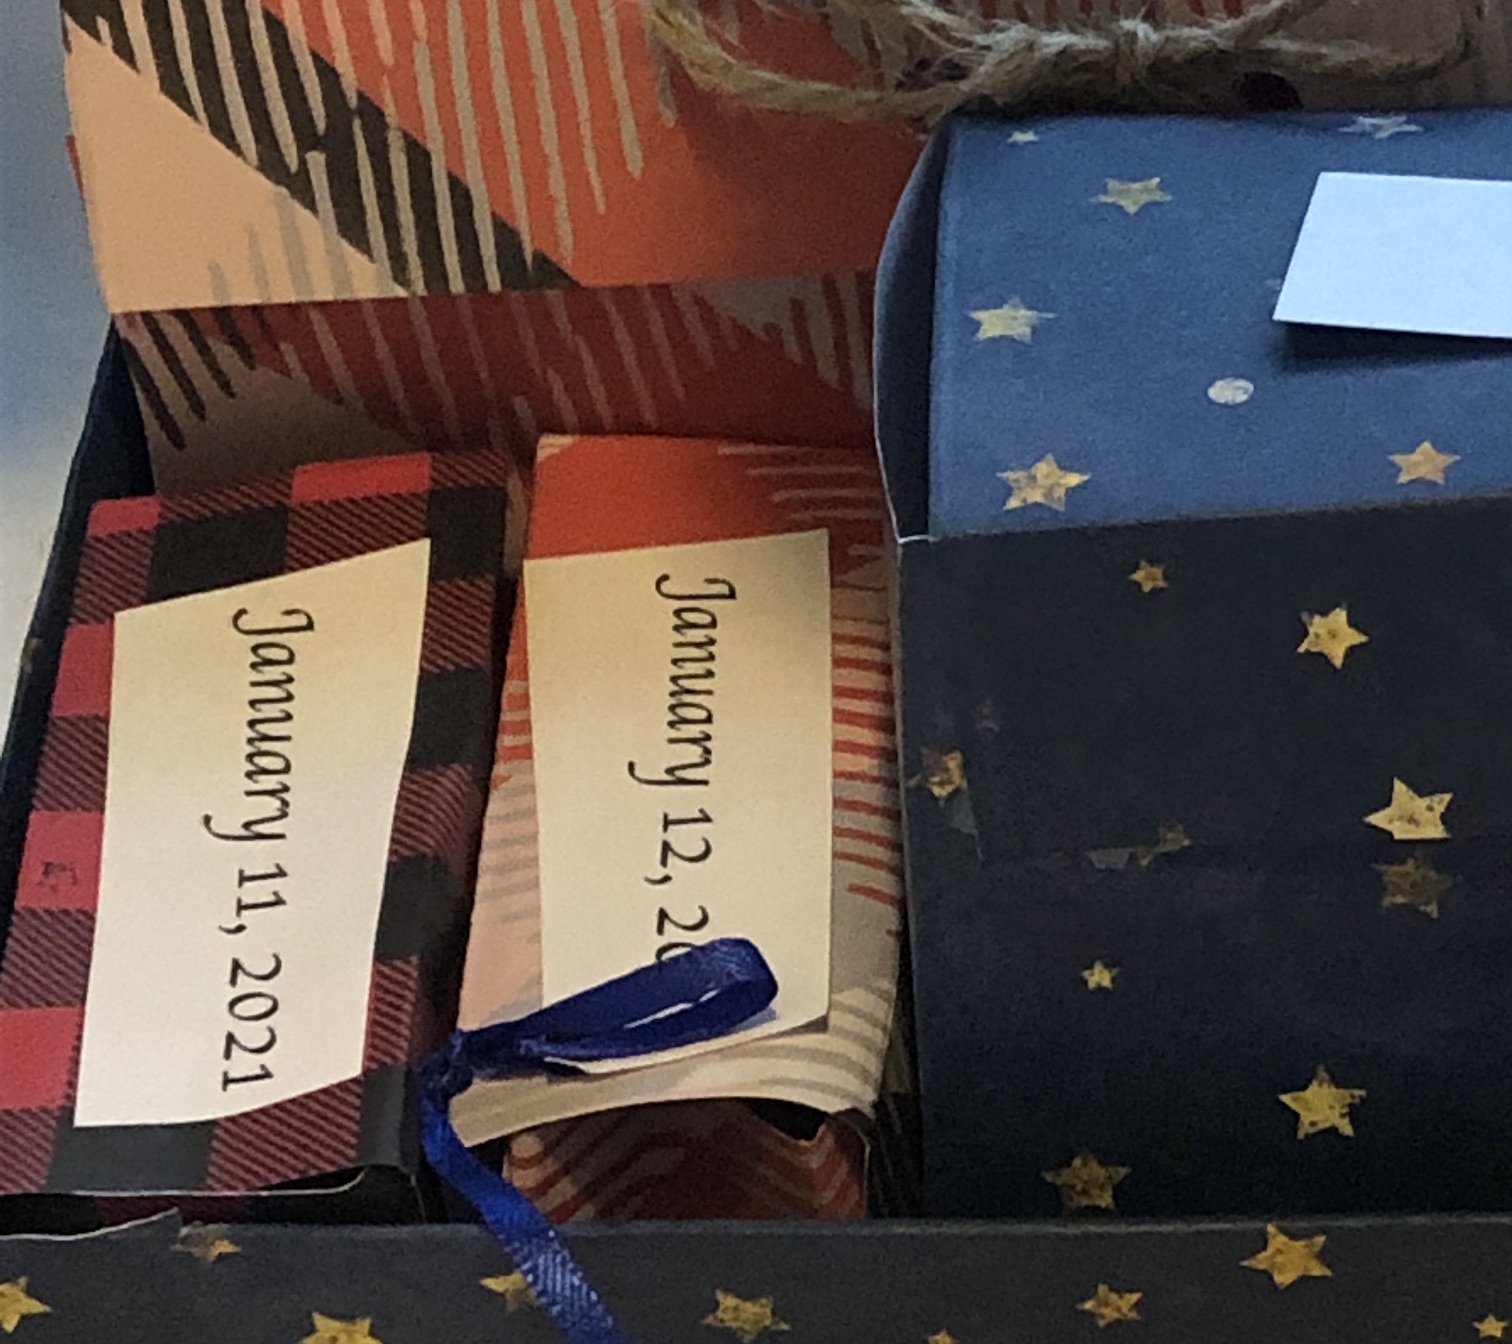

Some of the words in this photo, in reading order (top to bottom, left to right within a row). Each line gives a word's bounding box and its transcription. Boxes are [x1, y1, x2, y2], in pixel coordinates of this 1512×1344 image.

[202, 607, 315, 842] January
[627, 573, 738, 787] January
[218, 862, 289, 935] 11,
[644, 807, 714, 886] 12,
[221, 953, 283, 1092] 2021
